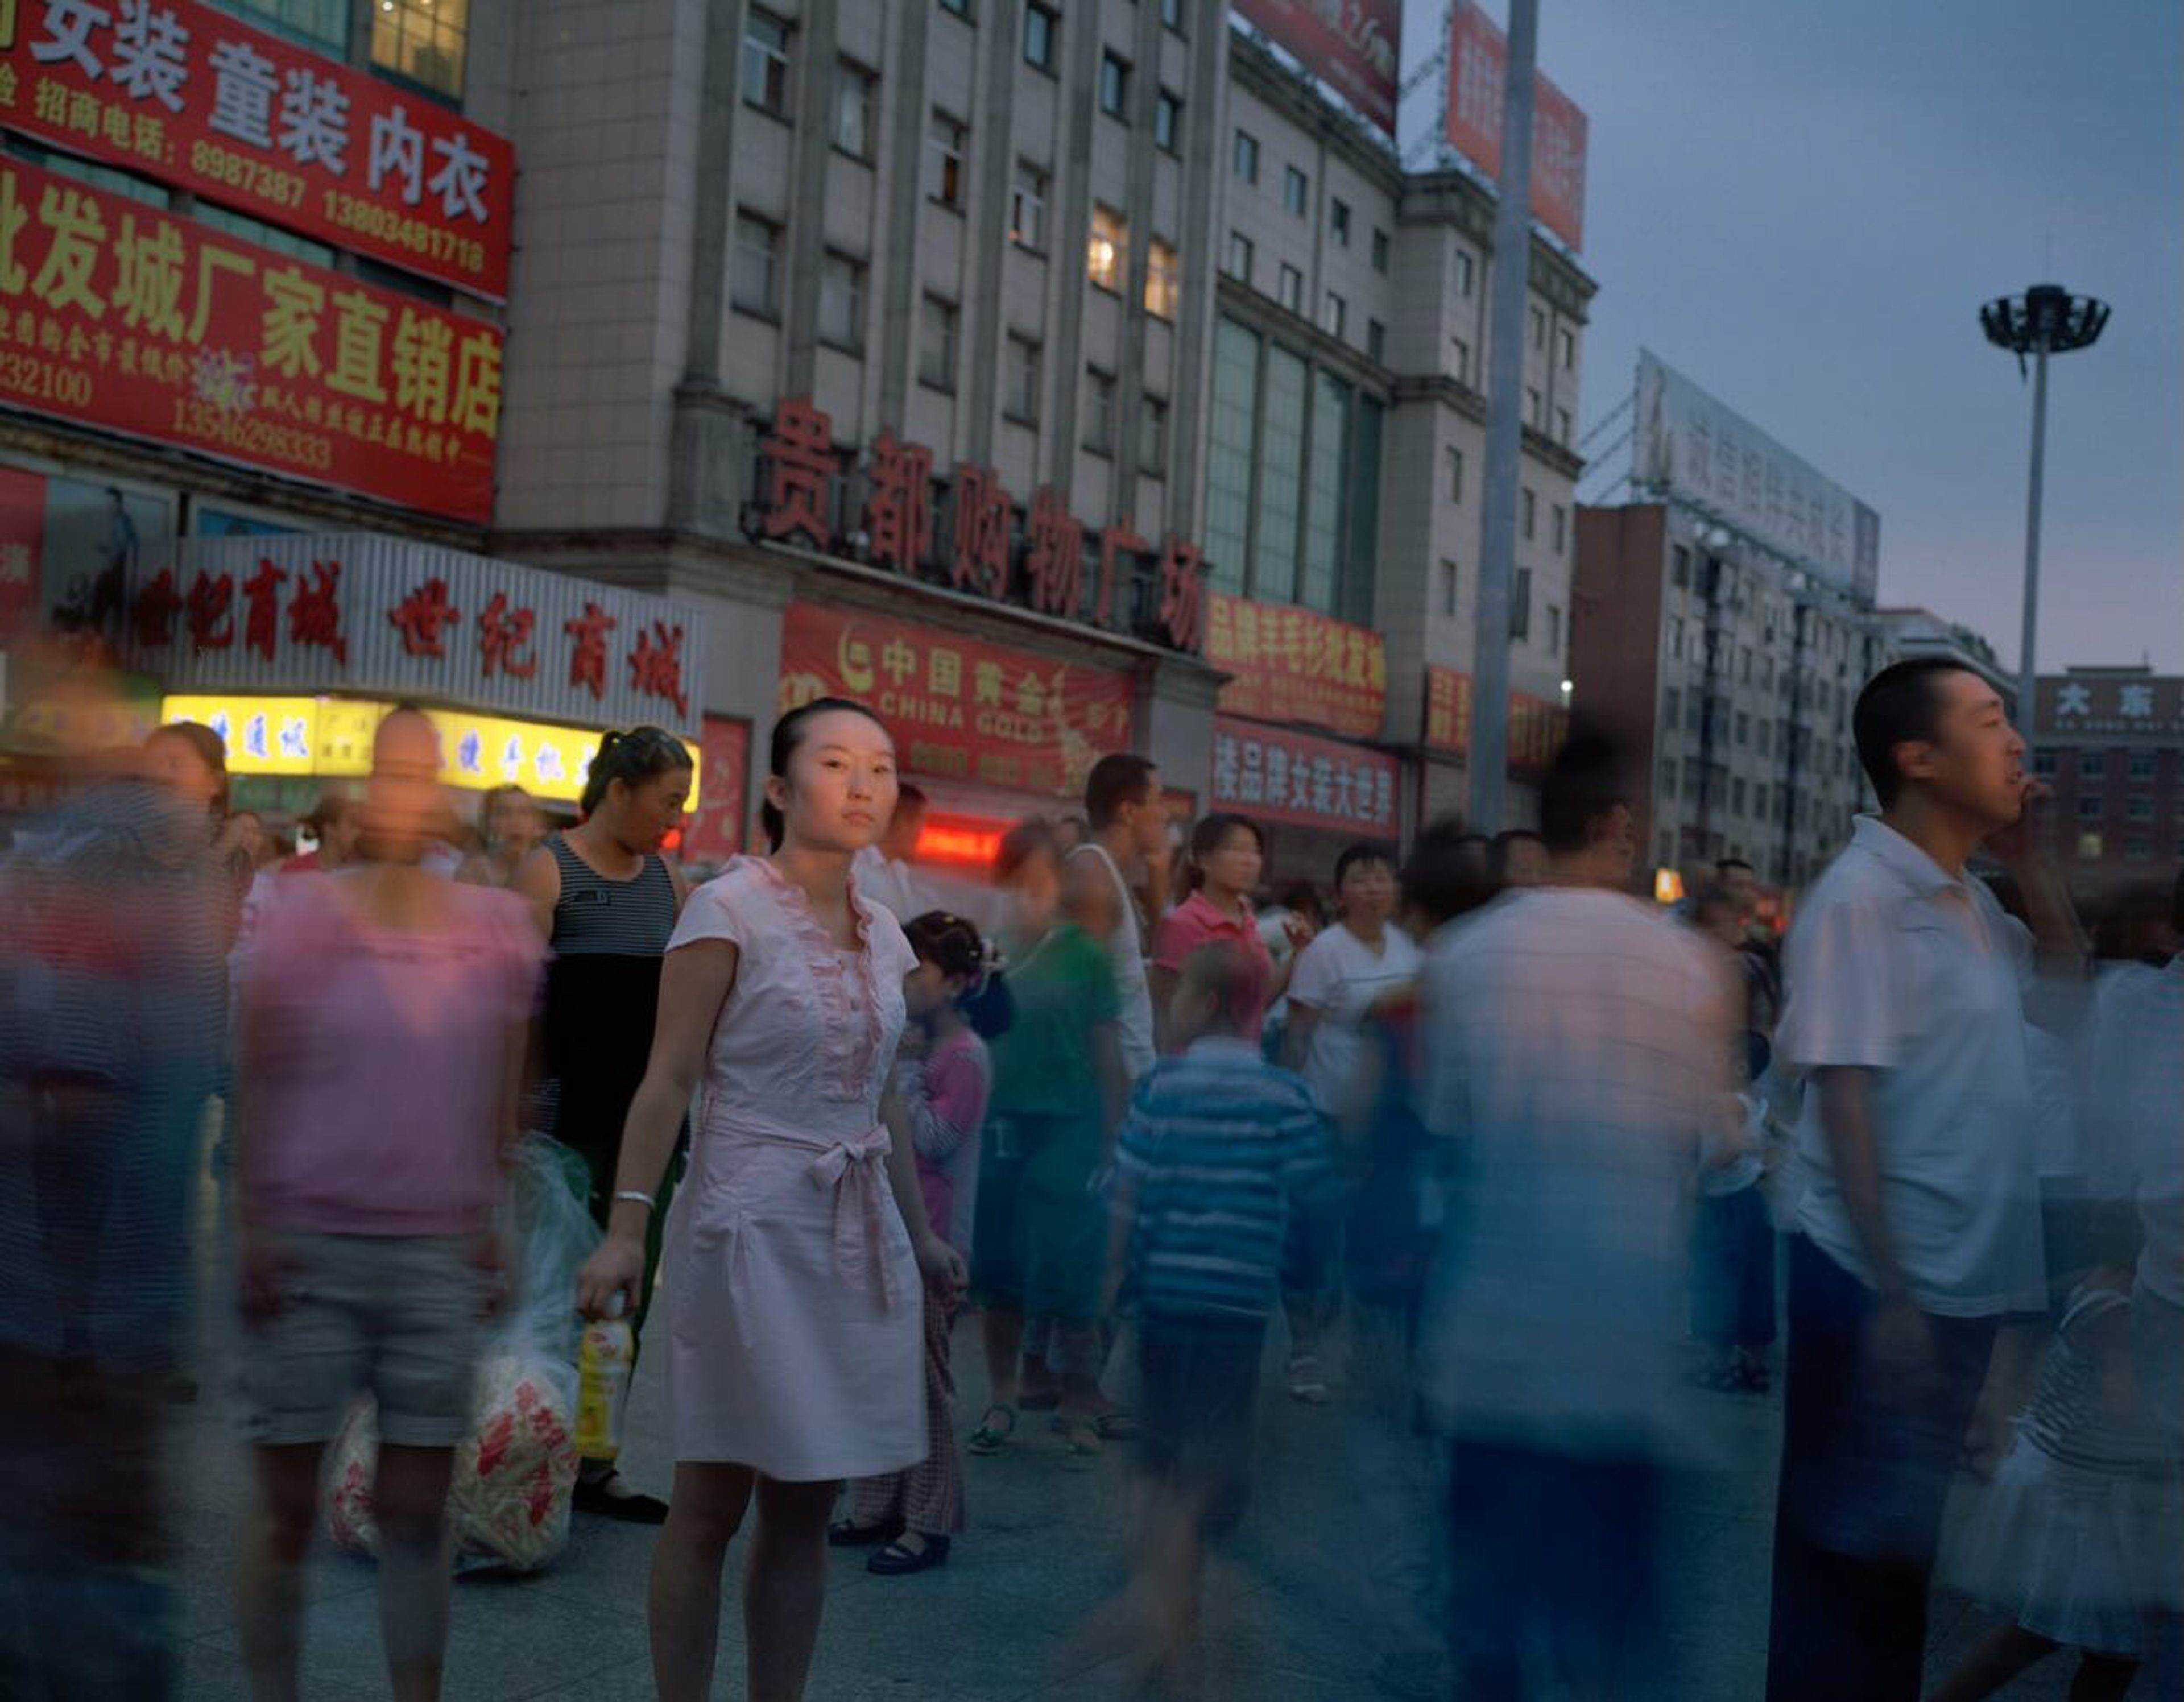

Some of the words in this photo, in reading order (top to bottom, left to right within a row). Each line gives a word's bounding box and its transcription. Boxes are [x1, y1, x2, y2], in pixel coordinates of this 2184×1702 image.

[29, 0, 191, 113] 女装
[208, 39, 351, 175] 童装
[367, 105, 489, 224] 内衣
[190, 138, 307, 209] 8987387
[0, 349, 93, 408] 32100
[761, 392, 1203, 654] 贵都购物广场
[388, 574, 689, 719] 世纪商城
[882, 637, 1046, 716] 中国黄金
[880, 691, 965, 729] CHINA
[975, 714, 1044, 744] GOLD
